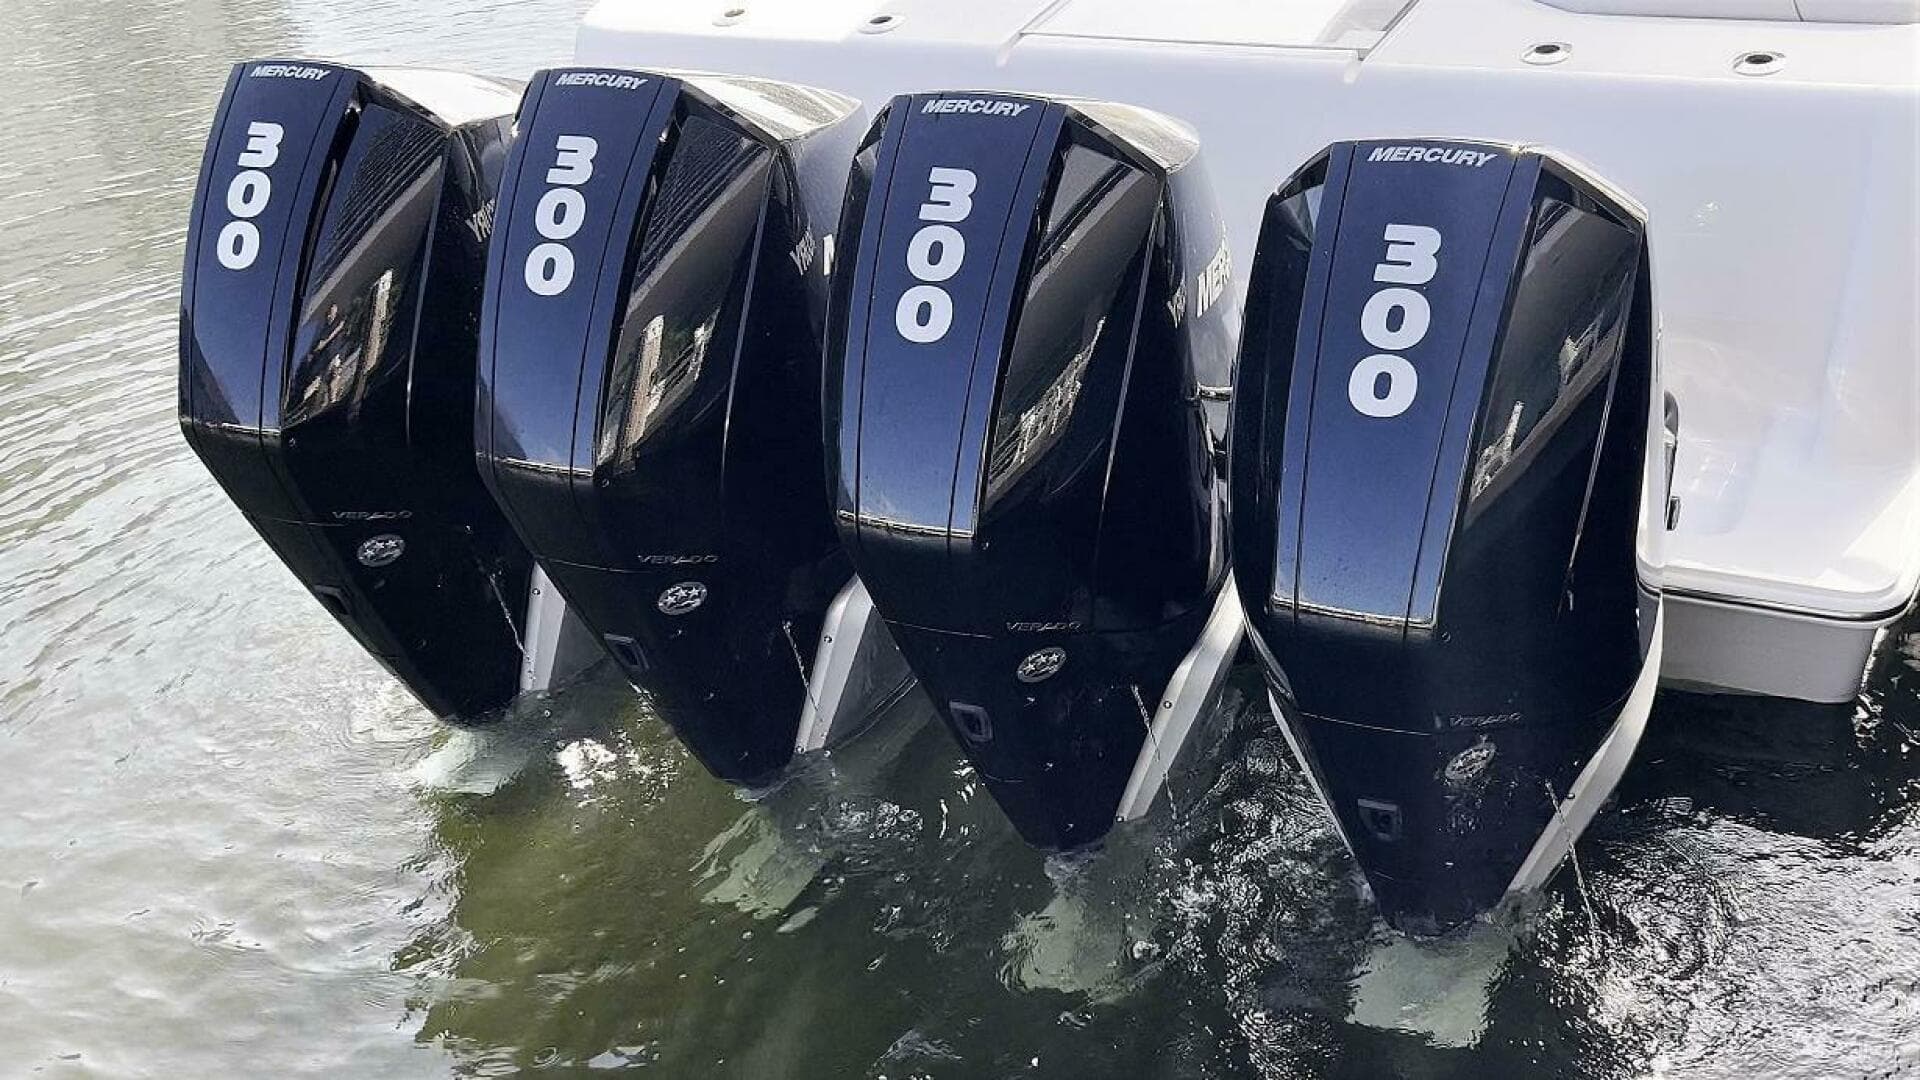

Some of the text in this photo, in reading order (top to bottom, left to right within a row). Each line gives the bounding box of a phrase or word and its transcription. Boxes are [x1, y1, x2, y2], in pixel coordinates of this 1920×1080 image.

[250, 64, 331, 81] MERCURY
[555, 72, 649, 89] MERCURY
[920, 99, 1031, 117] MERCURY
[217, 121, 284, 270] 300
[1367, 146, 1496, 168] MERCURY
[525, 135, 599, 296] 300
[895, 167, 977, 343] 300
[1348, 223, 1442, 418] 300
